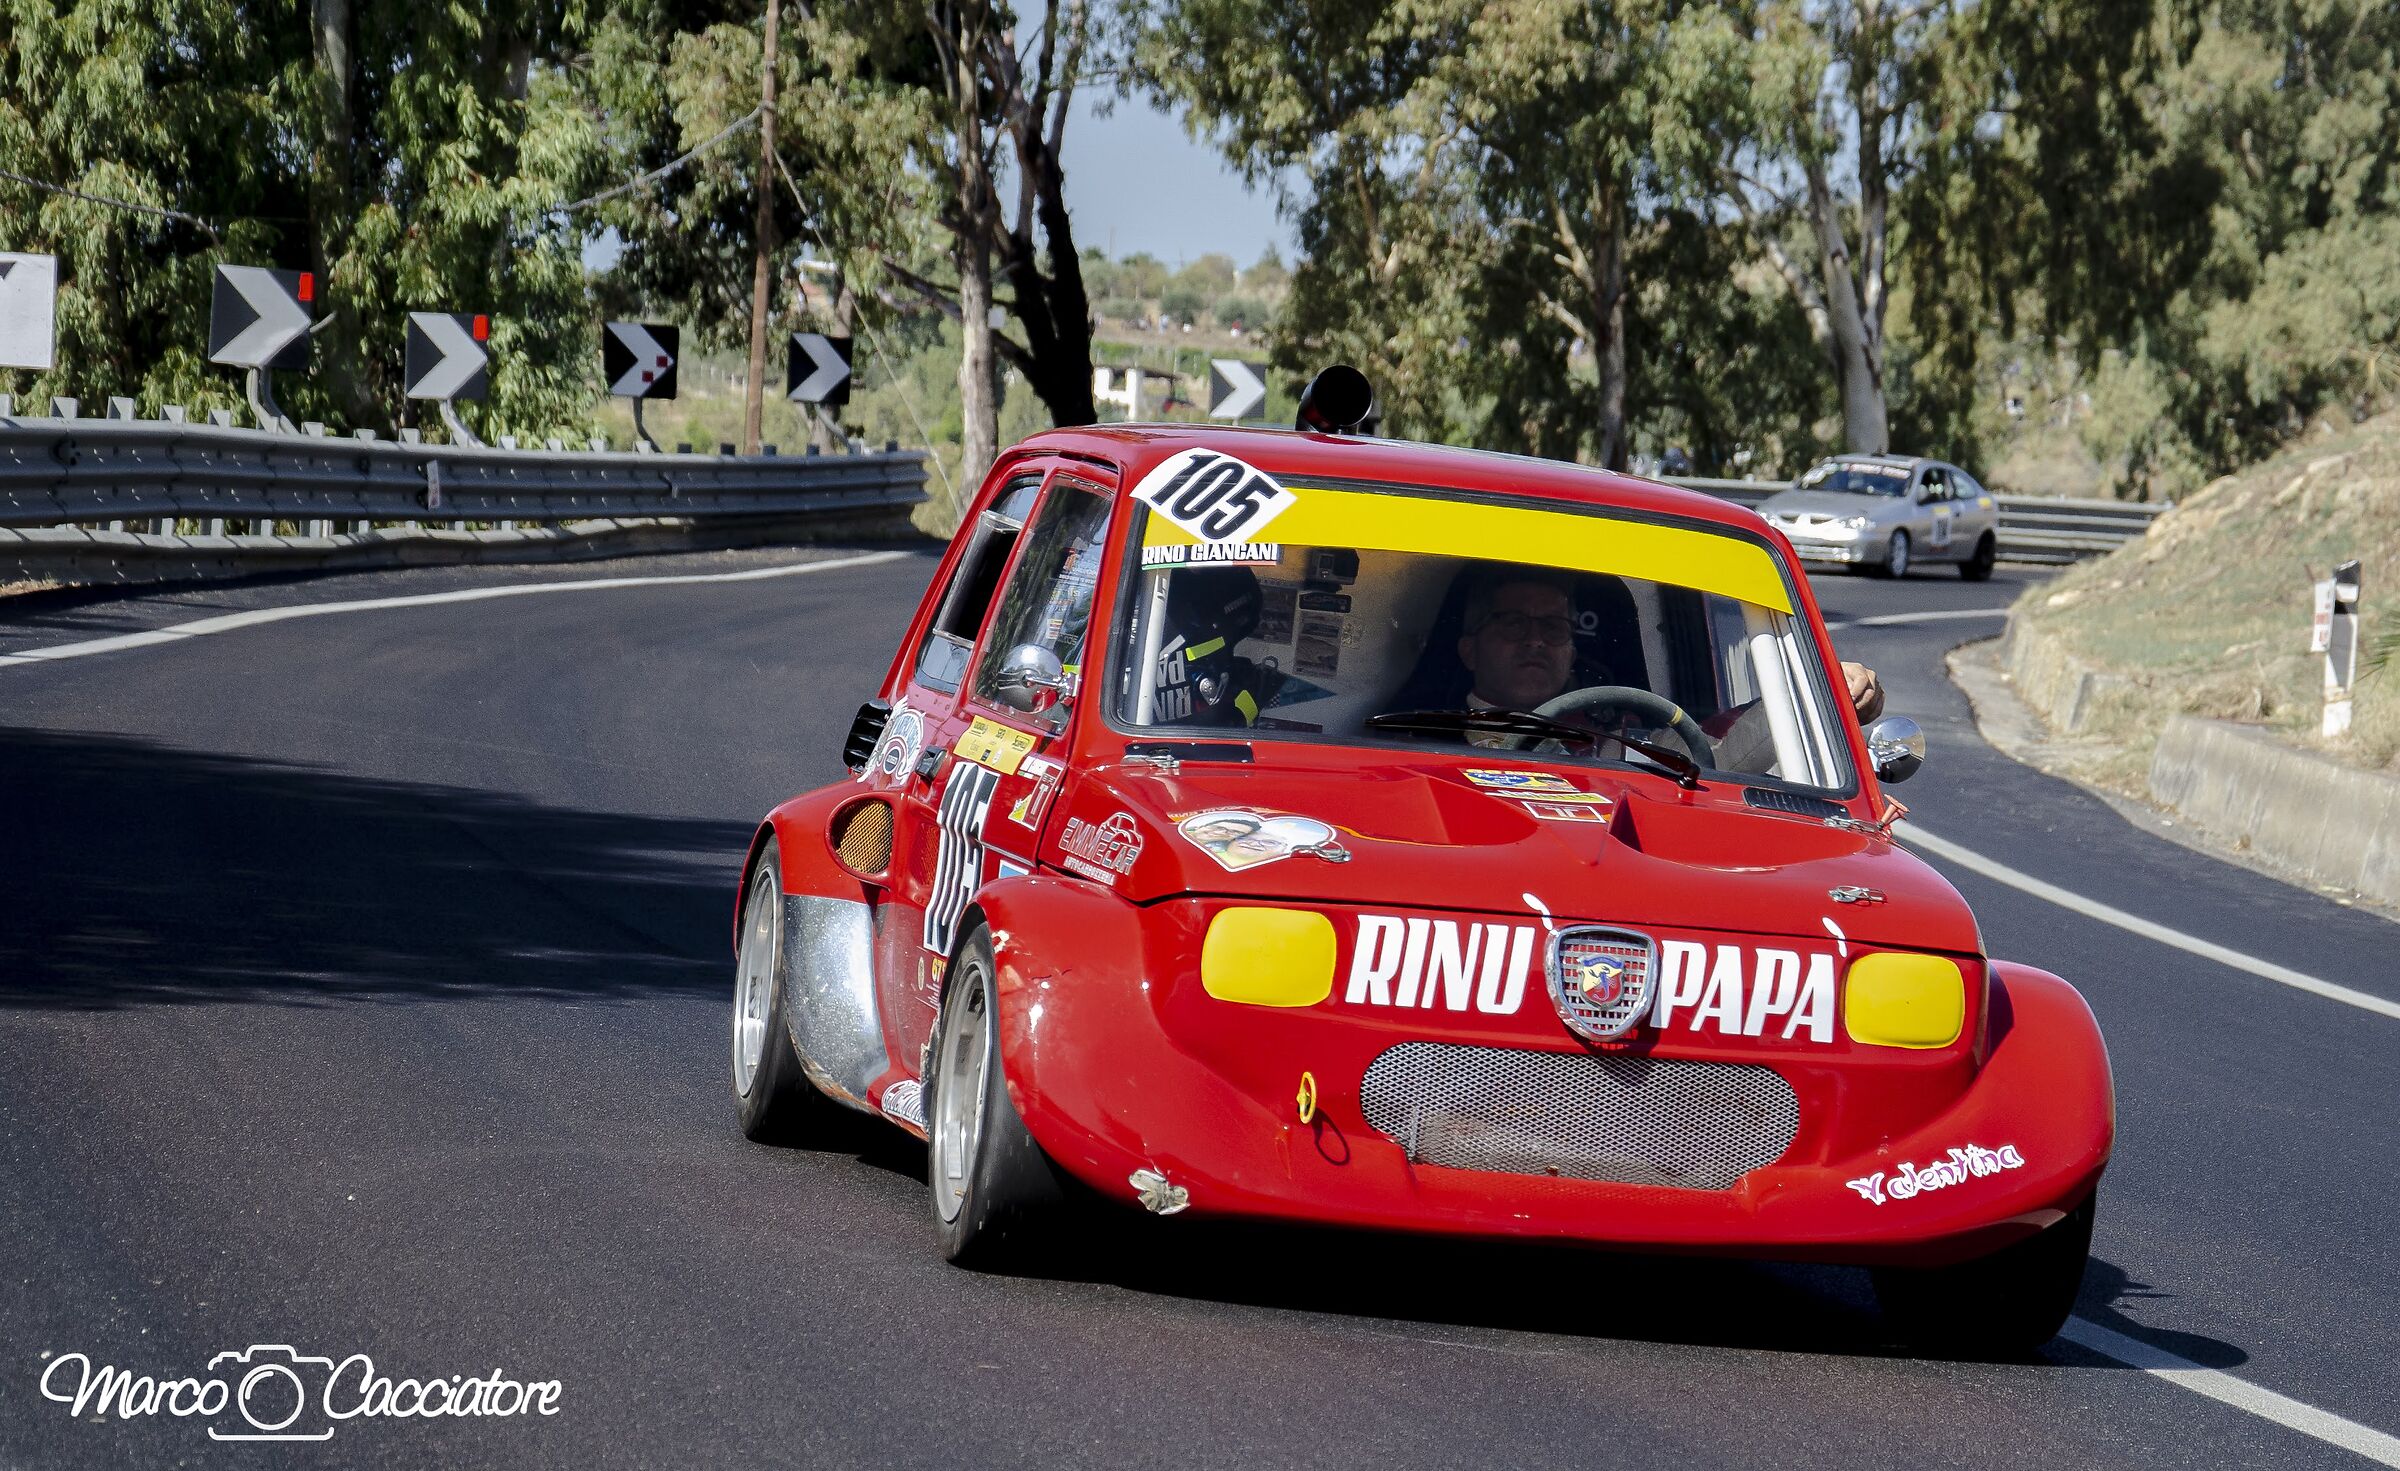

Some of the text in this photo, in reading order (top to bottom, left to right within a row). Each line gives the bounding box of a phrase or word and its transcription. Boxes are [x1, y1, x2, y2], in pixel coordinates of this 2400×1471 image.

[1151, 454, 1279, 540] 105
[1142, 545, 1186, 565] RINO
[1345, 914, 1834, 1044] RINU PAPA
[1845, 1143, 2025, 1206] Valentina
